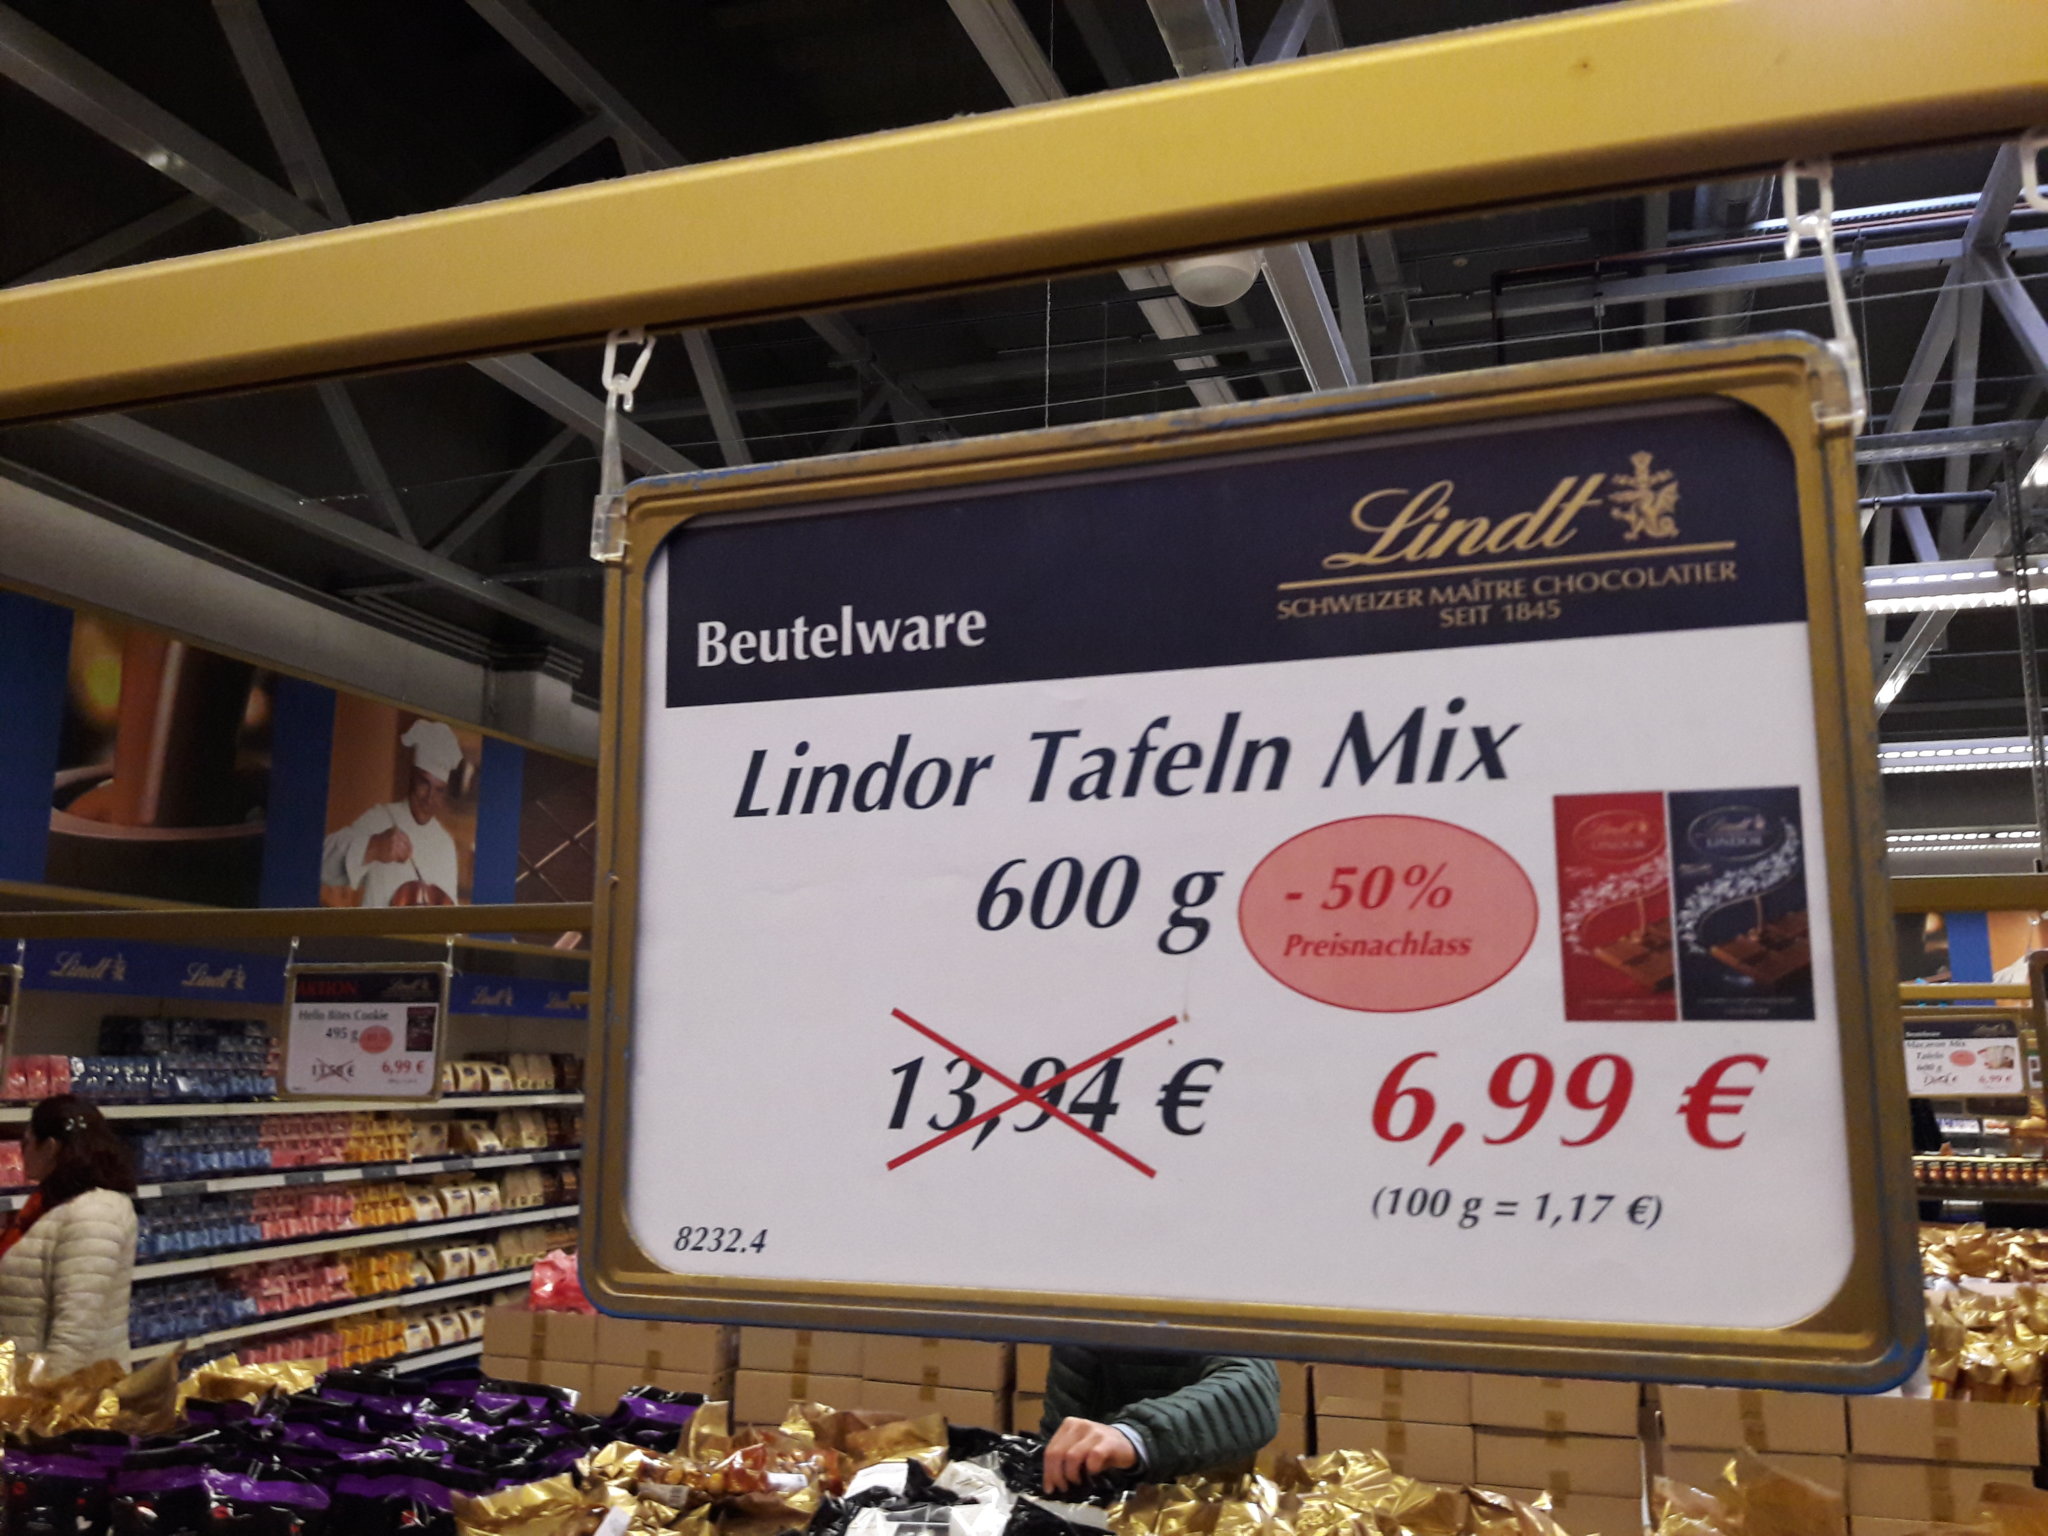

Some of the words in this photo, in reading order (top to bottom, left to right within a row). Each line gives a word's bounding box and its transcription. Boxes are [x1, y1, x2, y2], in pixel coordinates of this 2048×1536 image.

[1322, 473, 1606, 569] Lindt
[1277, 588, 1423, 619] SCHWEIZER
[1429, 577, 1527, 606] MAÎTRE
[1533, 561, 1737, 598] CHOCOLATIER
[1440, 605, 1490, 628] SEIT
[1502, 600, 1562, 623] 1845
[696, 605, 987, 668] Beutelware
[734, 733, 995, 818] Lindor
[1028, 711, 1291, 803] Tafeln
[1321, 697, 1523, 789] Mix
[976, 854, 1141, 931] 600
[1157, 871, 1225, 955] g
[1321, 861, 1454, 912] 50%
[49, 951, 113, 979] Lindt
[1282, 930, 1473, 959] Preisnachlass
[181, 961, 235, 988] Lindt
[299, 1009, 325, 1021] Hello
[327, 1009, 351, 1021] Bites
[353, 1009, 390, 1021] Cookie
[325, 1026, 348, 1040] 495
[381, 1060, 412, 1075] 6,99
[416, 1060, 425, 1074] €
[886, 1055, 1125, 1152] 13,94
[1155, 1057, 1225, 1137] €
[1371, 1051, 1635, 1168] 6,99
[1676, 1053, 1769, 1151] €
[1371, 1186, 1452, 1221] (100
[1457, 1197, 1484, 1229] g
[1495, 1202, 1519, 1217] =
[1534, 1193, 1615, 1229] 1,17
[1627, 1194, 1663, 1228] €)
[673, 1226, 768, 1255] 8232.4
